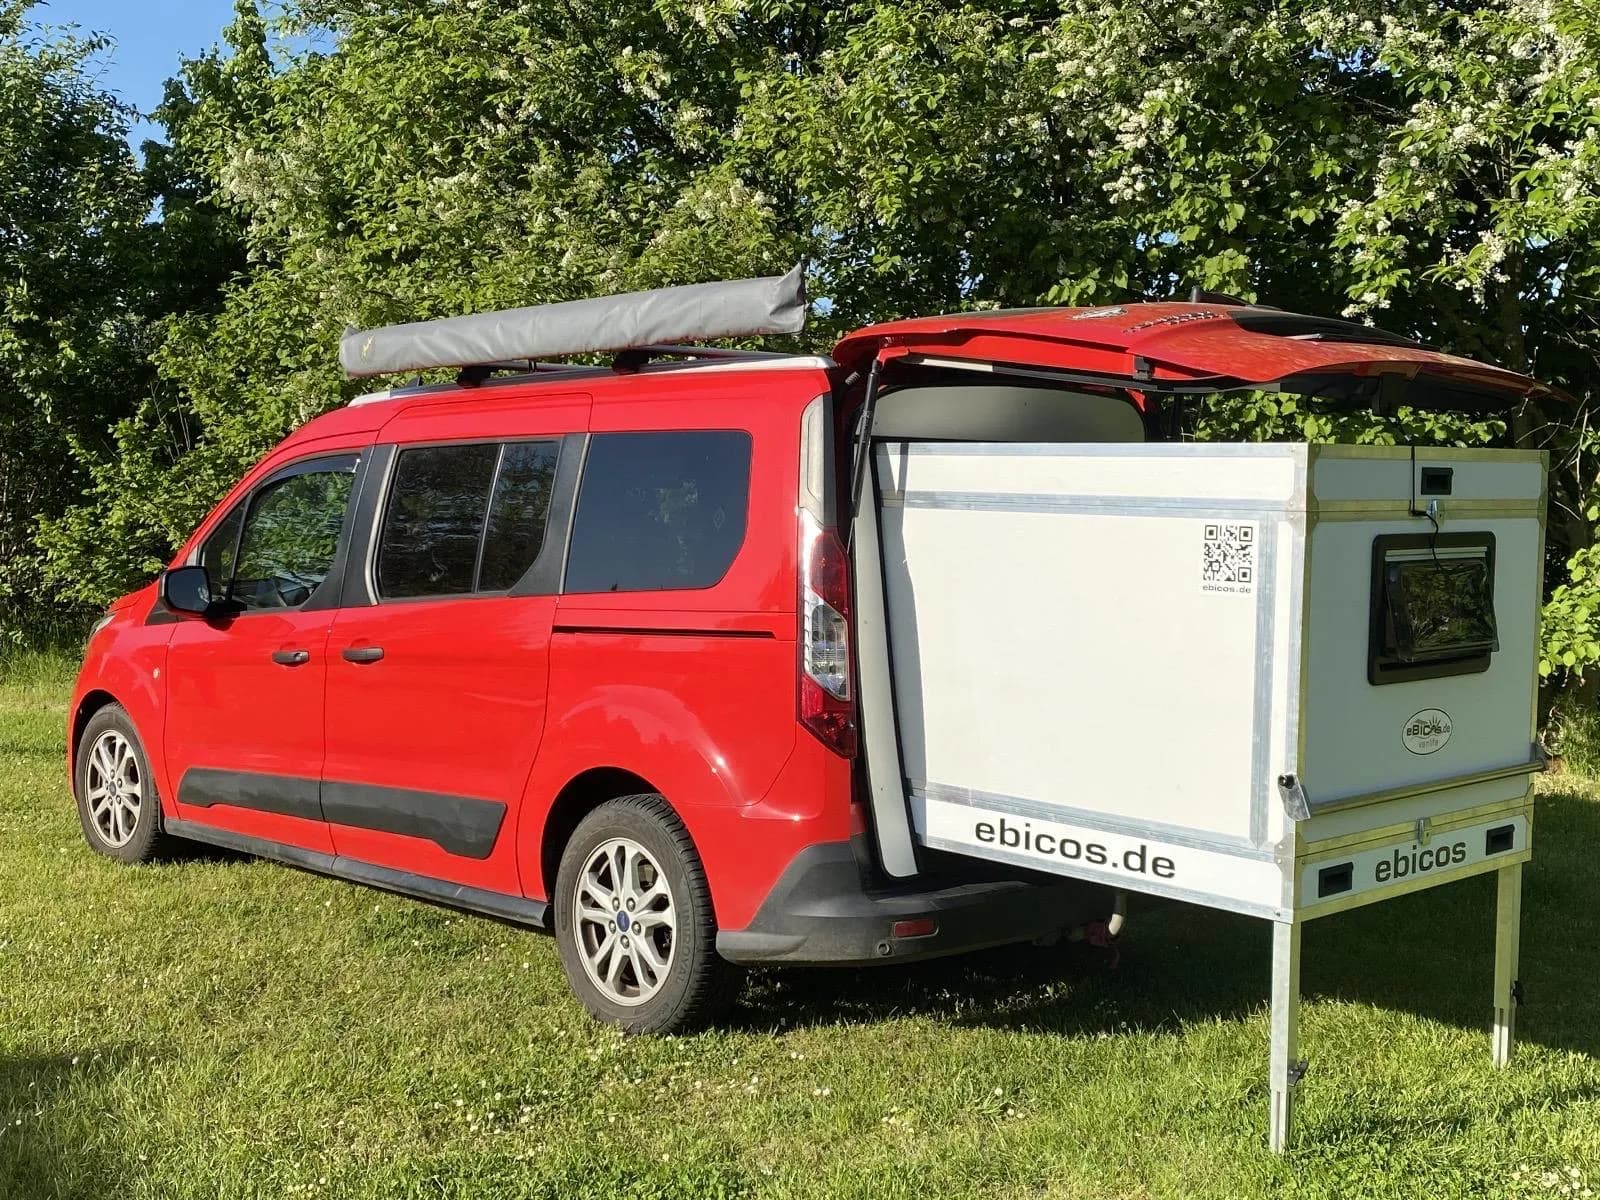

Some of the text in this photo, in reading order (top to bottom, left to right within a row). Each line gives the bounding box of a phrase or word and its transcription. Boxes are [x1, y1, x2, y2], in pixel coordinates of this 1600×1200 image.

[1202, 583, 1252, 594] ebicos.de
[975, 818, 1176, 879] ebicos.de
[1375, 841, 1467, 883] ebicos
